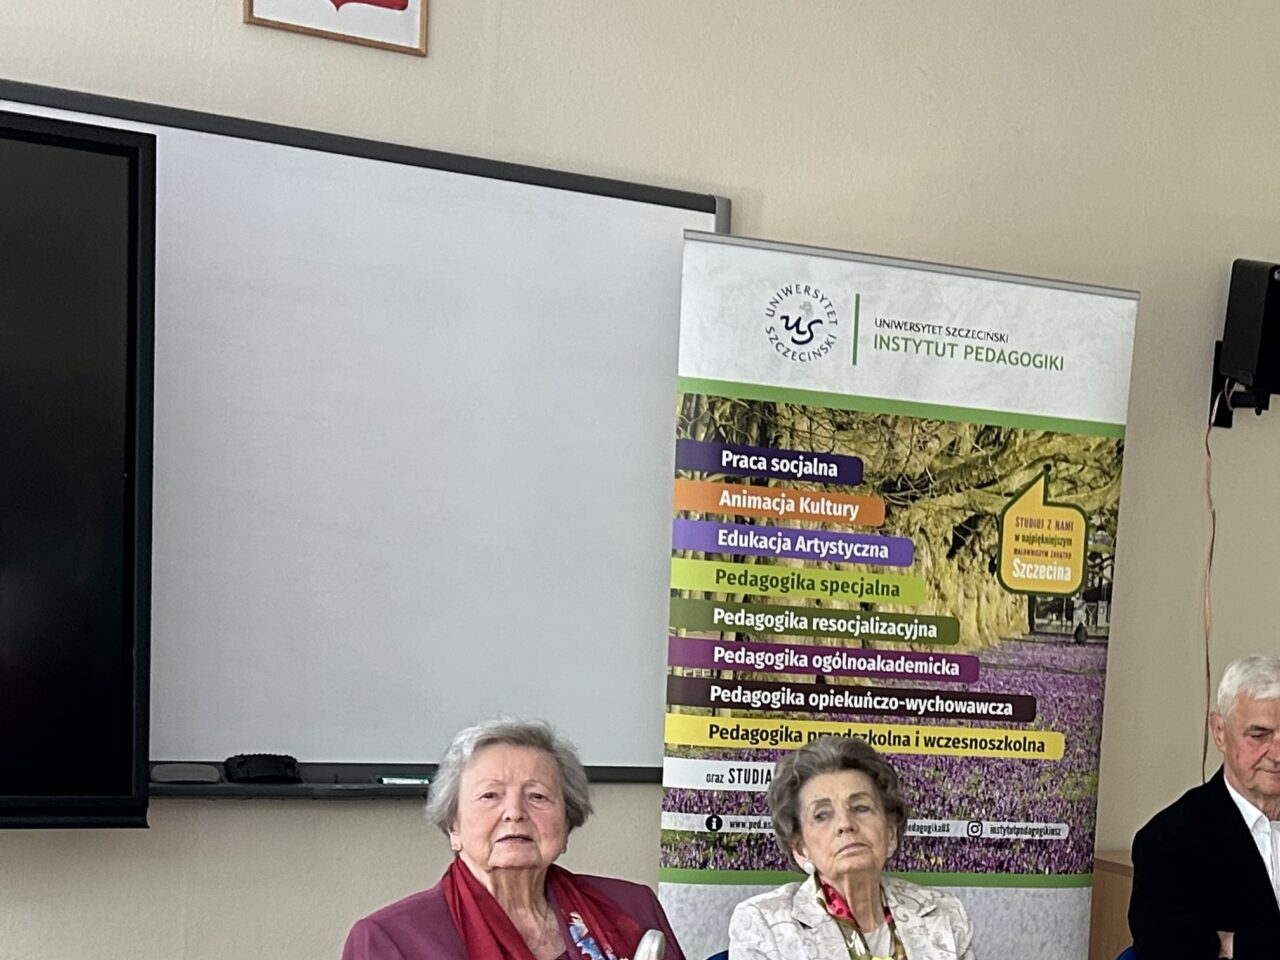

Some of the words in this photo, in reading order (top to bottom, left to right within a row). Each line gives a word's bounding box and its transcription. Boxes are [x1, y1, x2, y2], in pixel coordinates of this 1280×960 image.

[765, 284, 838, 326] UNIWERSYTET
[874, 317, 944, 336] UNIWERSYTET
[945, 326, 1009, 343] SZCZECIŃSKI
[873, 334, 959, 358] INSTYTUT
[964, 345, 1064, 371] PEDAGOGIKI
[721, 450, 767, 470] Praca
[771, 456, 838, 477] socjalna
[719, 490, 795, 515] Animacja
[799, 497, 860, 521] Kultury
[718, 529, 791, 554] Edukacja
[795, 535, 889, 559] Artystyczna
[716, 569, 815, 593] Pedagogika
[820, 577, 900, 598] specjalna
[1012, 558, 1072, 582] Szczecina
[713, 608, 808, 633] Pedagogika
[812, 615, 937, 640] resocjalizacyjna
[713, 646, 808, 671] Pedagogika
[812, 651, 960, 676] ogólnoakademicka
[710, 685, 804, 709] Pedagogika
[808, 690, 1013, 716] opiekuńczo-wychowawcza
[709, 724, 803, 746] Pedagogika
[915, 731, 920, 747] i
[924, 735, 1045, 753] wczesnoszkolna
[706, 773, 724, 784] oraz
[728, 768, 772, 785] STUDIA
